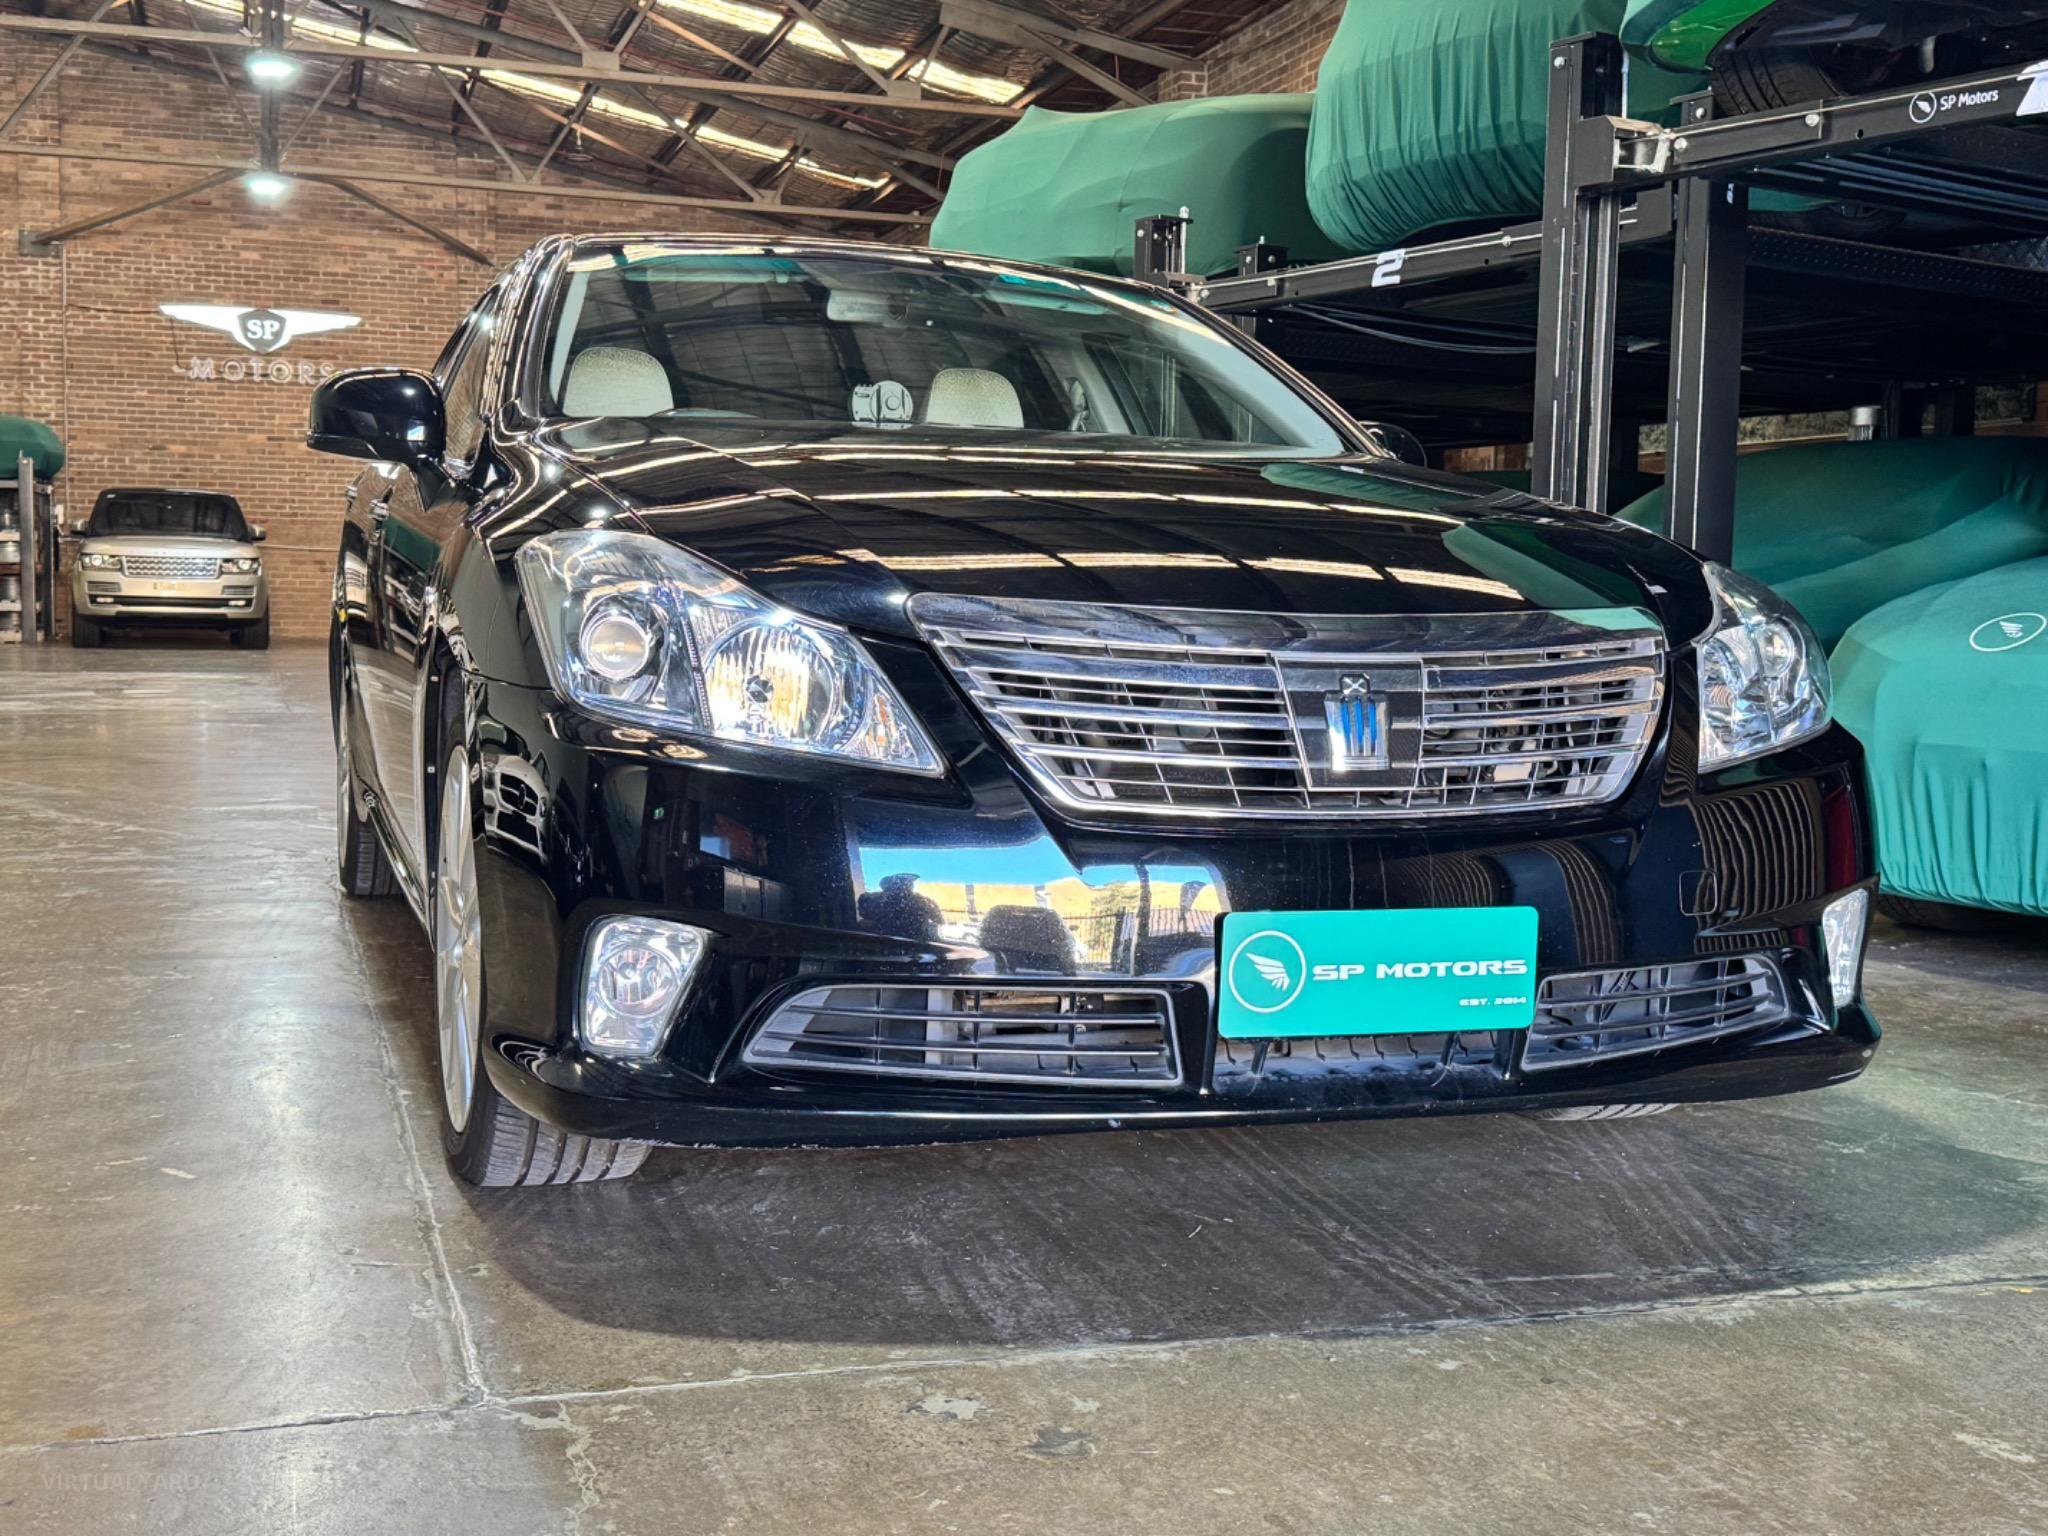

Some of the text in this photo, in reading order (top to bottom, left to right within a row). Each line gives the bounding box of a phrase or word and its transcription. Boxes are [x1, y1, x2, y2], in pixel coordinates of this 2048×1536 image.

[1940, 90, 1999, 111] SP Motors
[1371, 248, 1406, 288] 2
[247, 318, 281, 340] SP
[1312, 959, 1528, 981] SP MOTORS
[1459, 998, 1491, 1006] EST.
